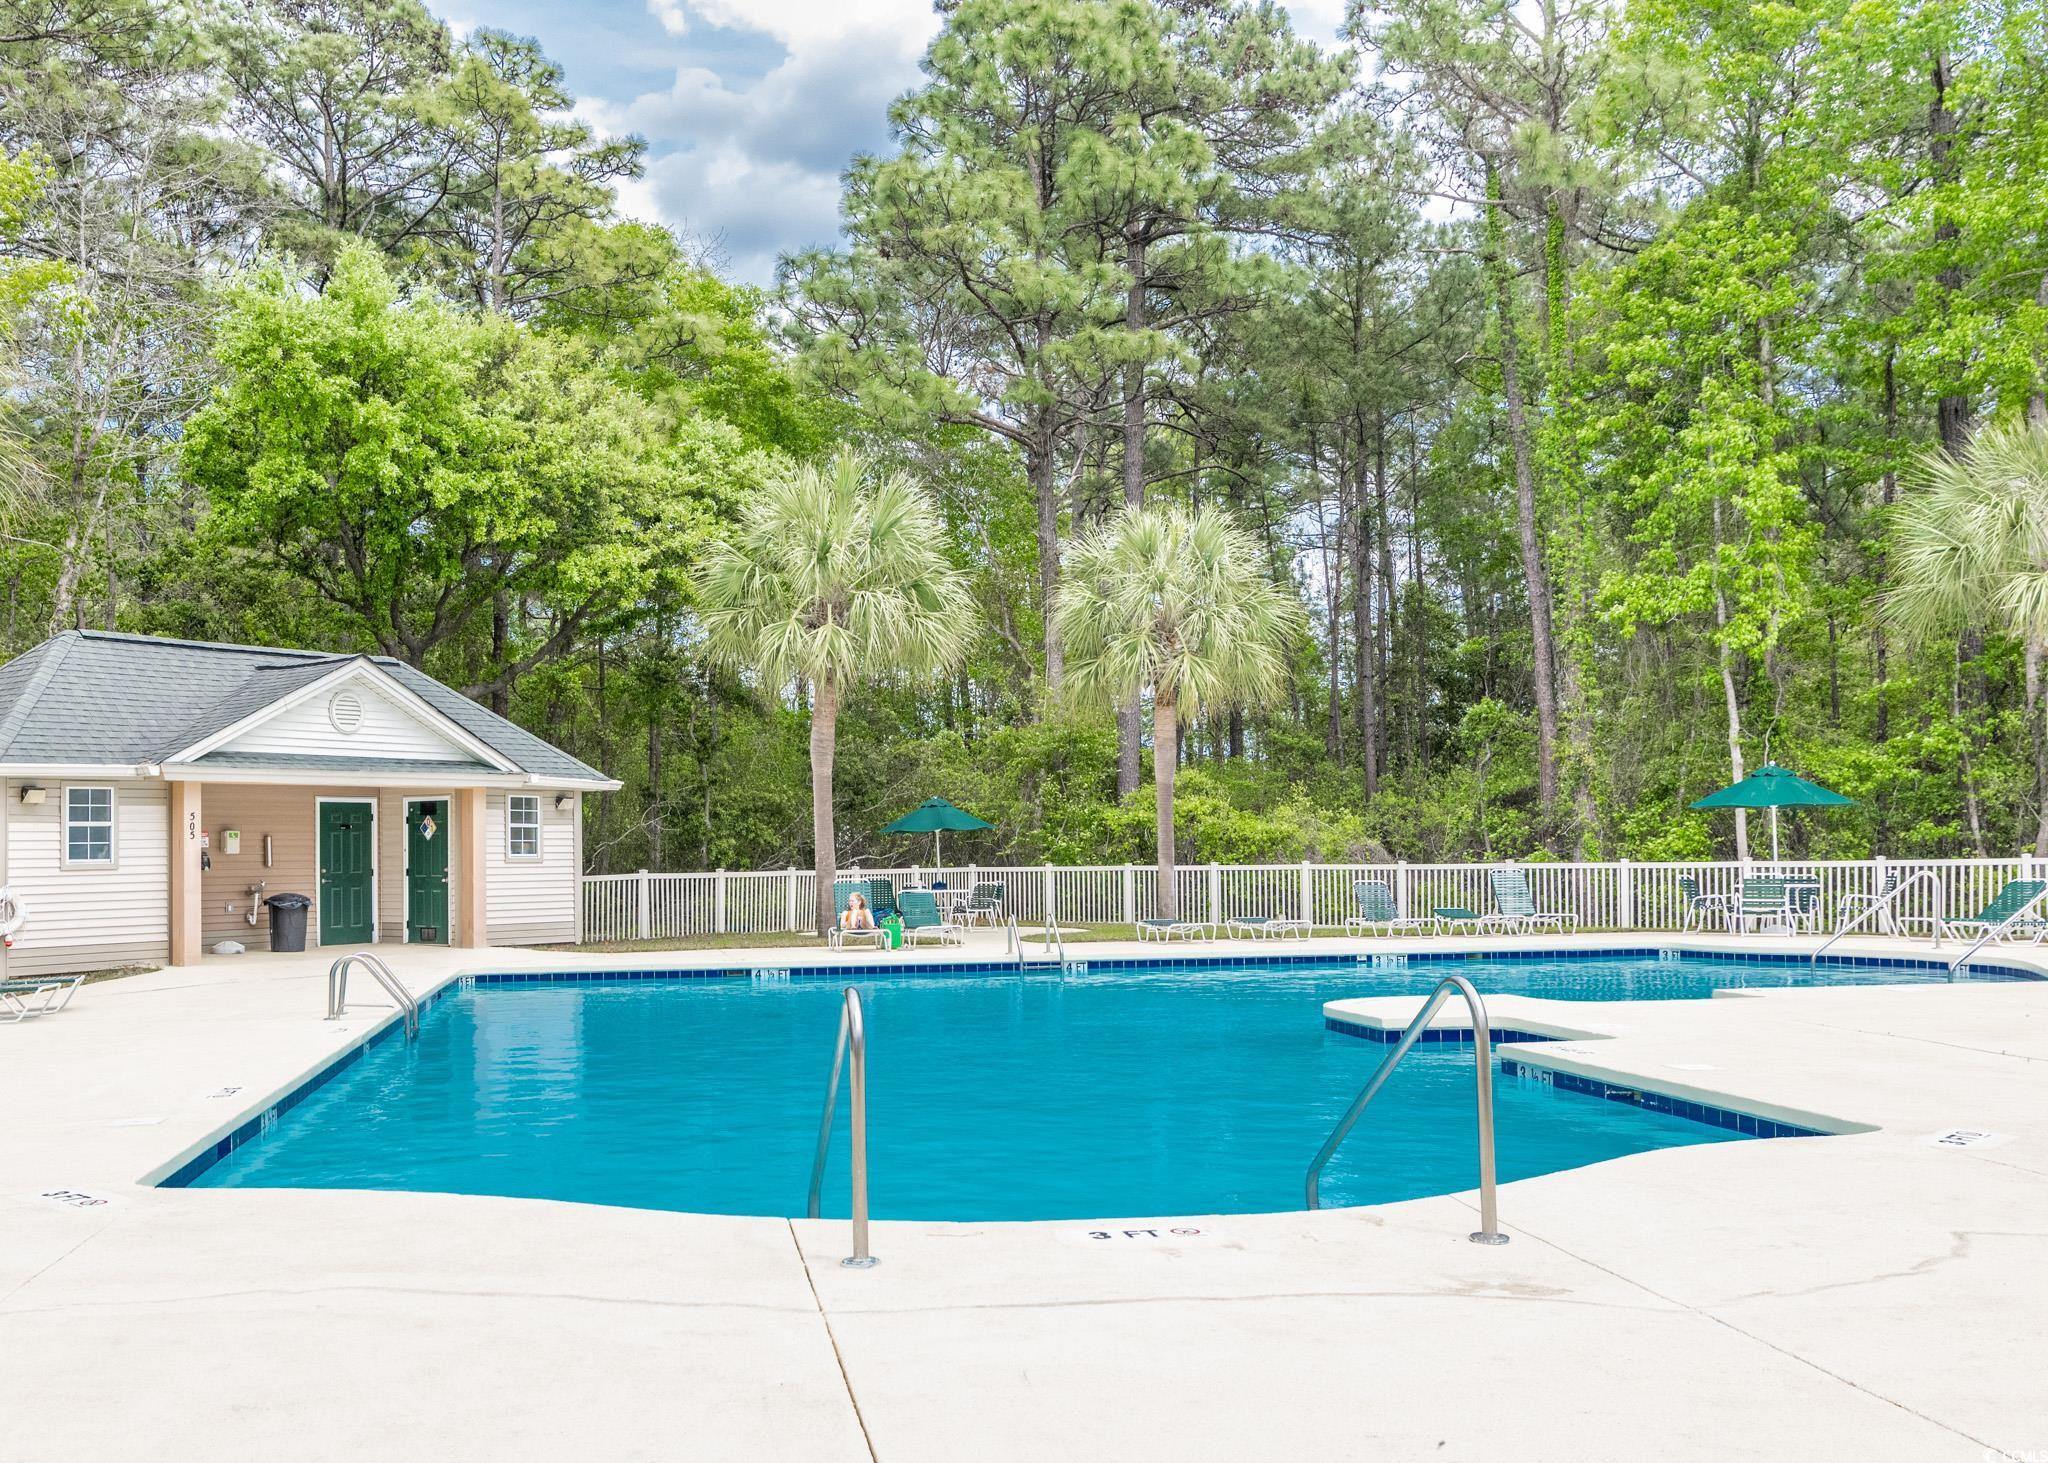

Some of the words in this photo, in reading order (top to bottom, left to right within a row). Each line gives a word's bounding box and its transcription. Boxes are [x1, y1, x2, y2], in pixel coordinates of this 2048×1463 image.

[1671, 950, 1680, 960] FT
[1396, 955, 1407, 967] FT
[1076, 962, 1087, 972] FT
[778, 969, 789, 980] FT
[1520, 1066, 1526, 1078] 3
[1541, 1070, 1552, 1086] FT
[1088, 1231, 1112, 1240] 3
[1121, 1229, 1159, 1239] FT
